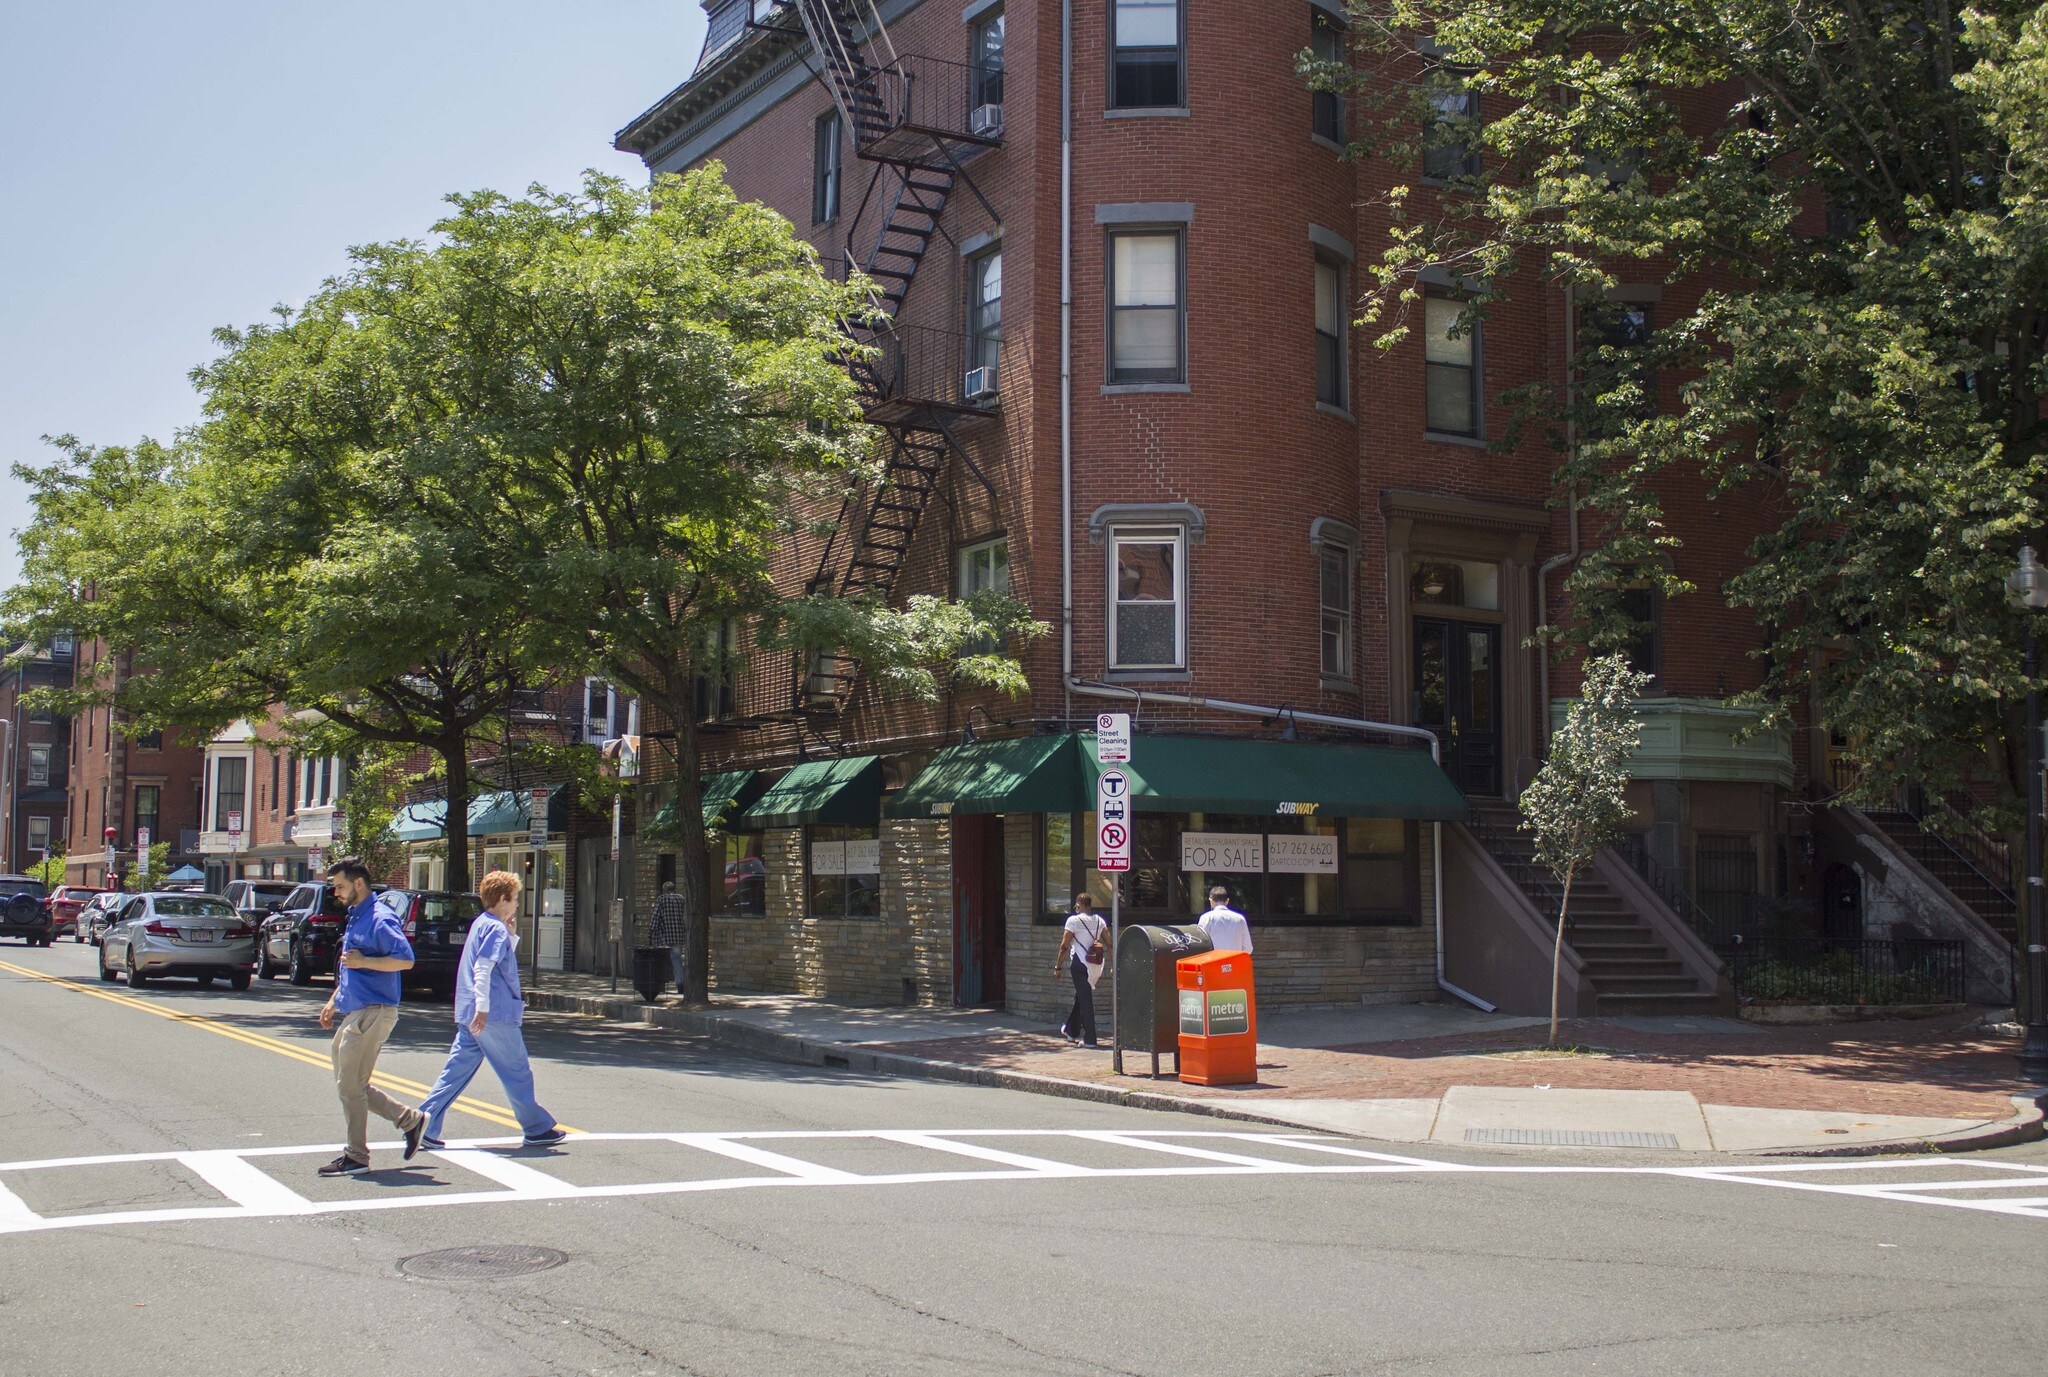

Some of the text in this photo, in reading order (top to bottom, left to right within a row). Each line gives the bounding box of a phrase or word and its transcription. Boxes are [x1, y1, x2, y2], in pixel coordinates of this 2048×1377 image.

[1104, 778, 1123, 794] T
[930, 801, 955, 815] SUBWAY
[1276, 802, 1319, 815] SUBWAY
[1184, 837, 1259, 847] RETAIL/RESTAURANT SPACE
[1270, 842, 1333, 855] 617 262 6620
[813, 854, 826, 870] FOR
[828, 854, 844, 870] SALE
[1184, 847, 1260, 868] FOR SALE
[1211, 1002, 1245, 1016] metro
